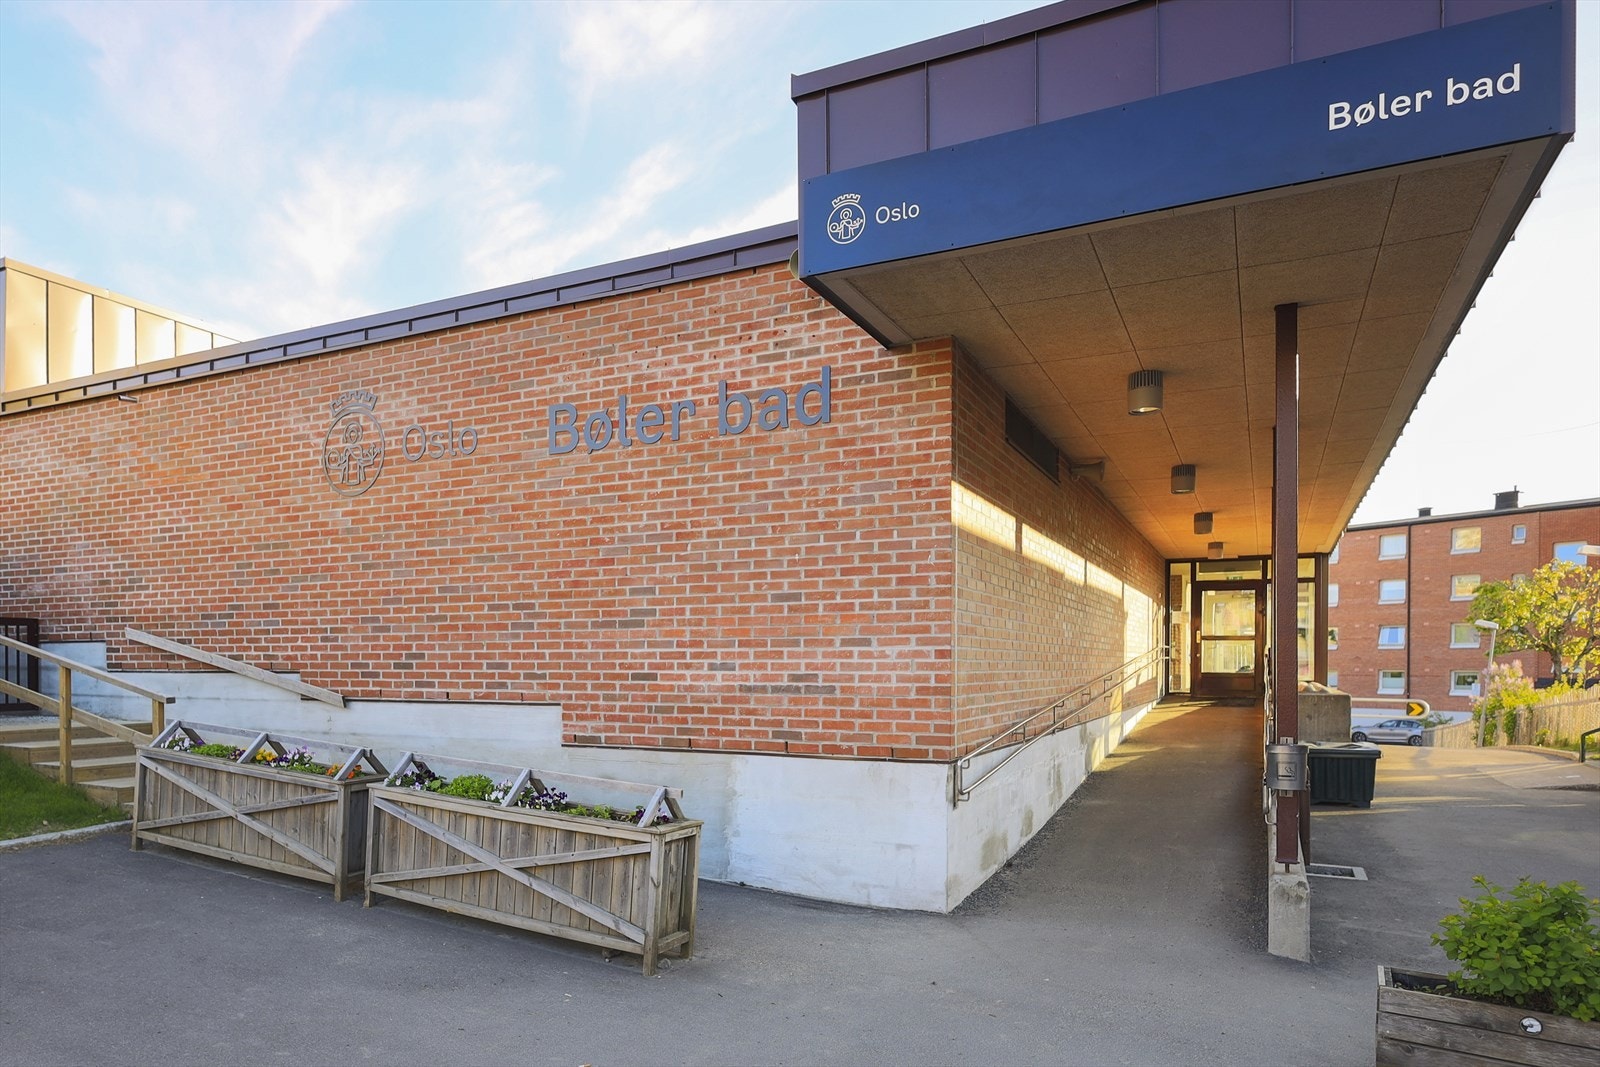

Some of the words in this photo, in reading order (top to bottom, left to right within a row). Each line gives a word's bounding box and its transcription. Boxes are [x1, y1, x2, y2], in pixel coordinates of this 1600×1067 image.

[1328, 89, 1432, 131] Bøler
[1446, 63, 1521, 106] bad
[875, 201, 920, 224] Oslo
[547, 394, 696, 456] Bøler
[718, 365, 832, 436] bad
[401, 419, 479, 462] Oslo
